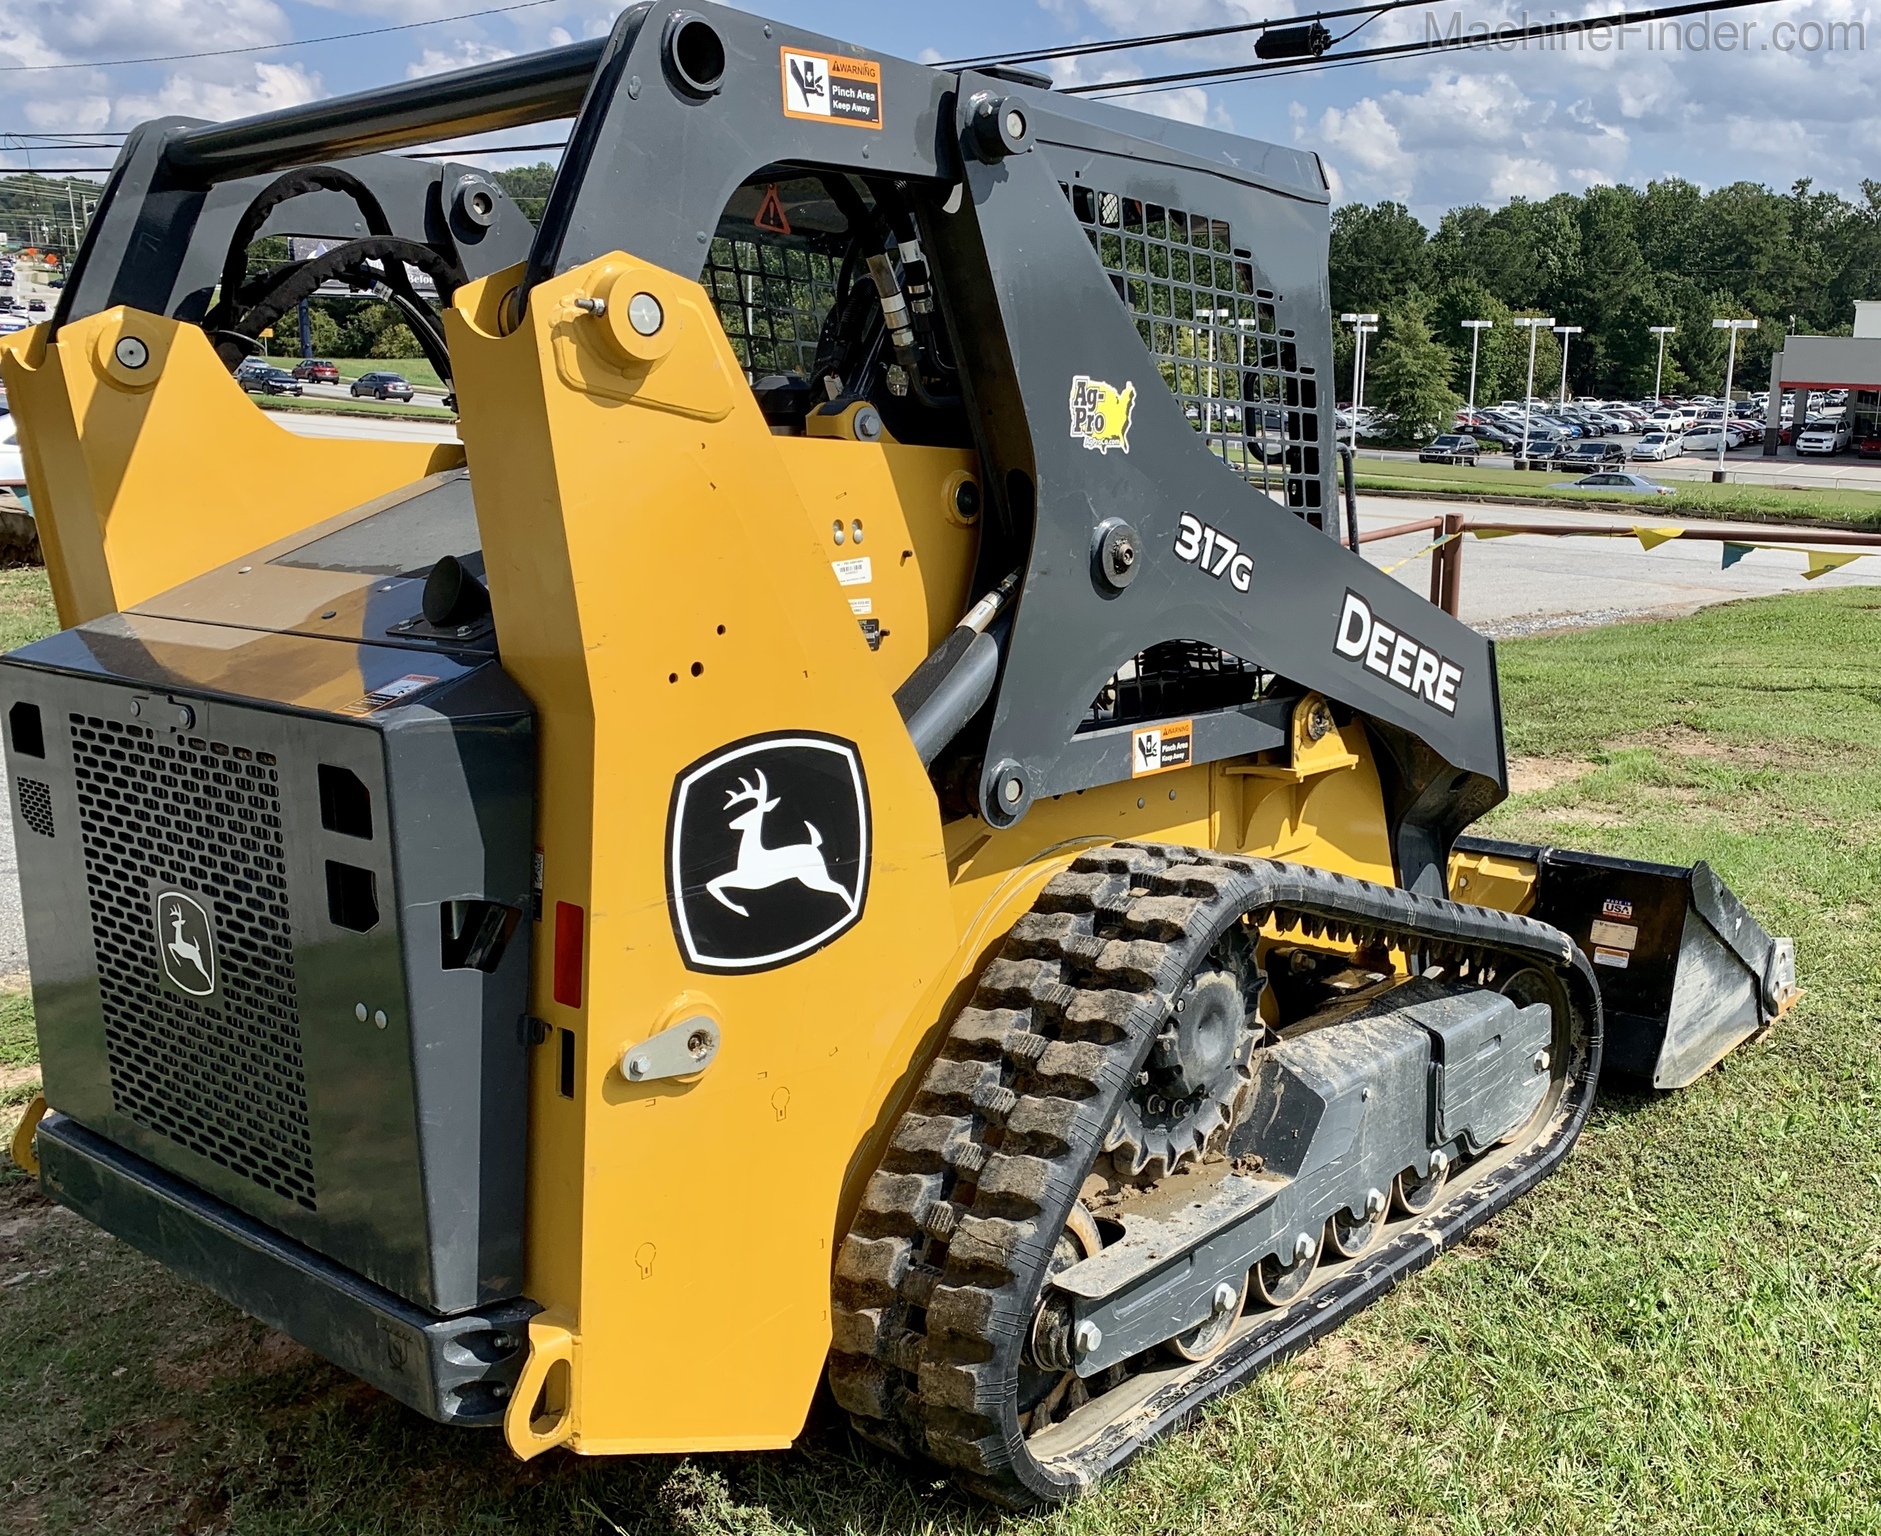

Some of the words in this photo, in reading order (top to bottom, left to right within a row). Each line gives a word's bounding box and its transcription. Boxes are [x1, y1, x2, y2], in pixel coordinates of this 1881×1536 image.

[839, 63, 876, 78] WARNING
[832, 84, 855, 98] Pinch
[856, 89, 876, 102] Area
[832, 100, 851, 112] Keep
[851, 101, 871, 115] Away
[1074, 381, 1105, 412] Ag-
[1074, 407, 1105, 433] Pro
[1174, 513, 1254, 592] 317G
[1334, 591, 1463, 715] DEERE
[1606, 904, 1630, 914] USA
